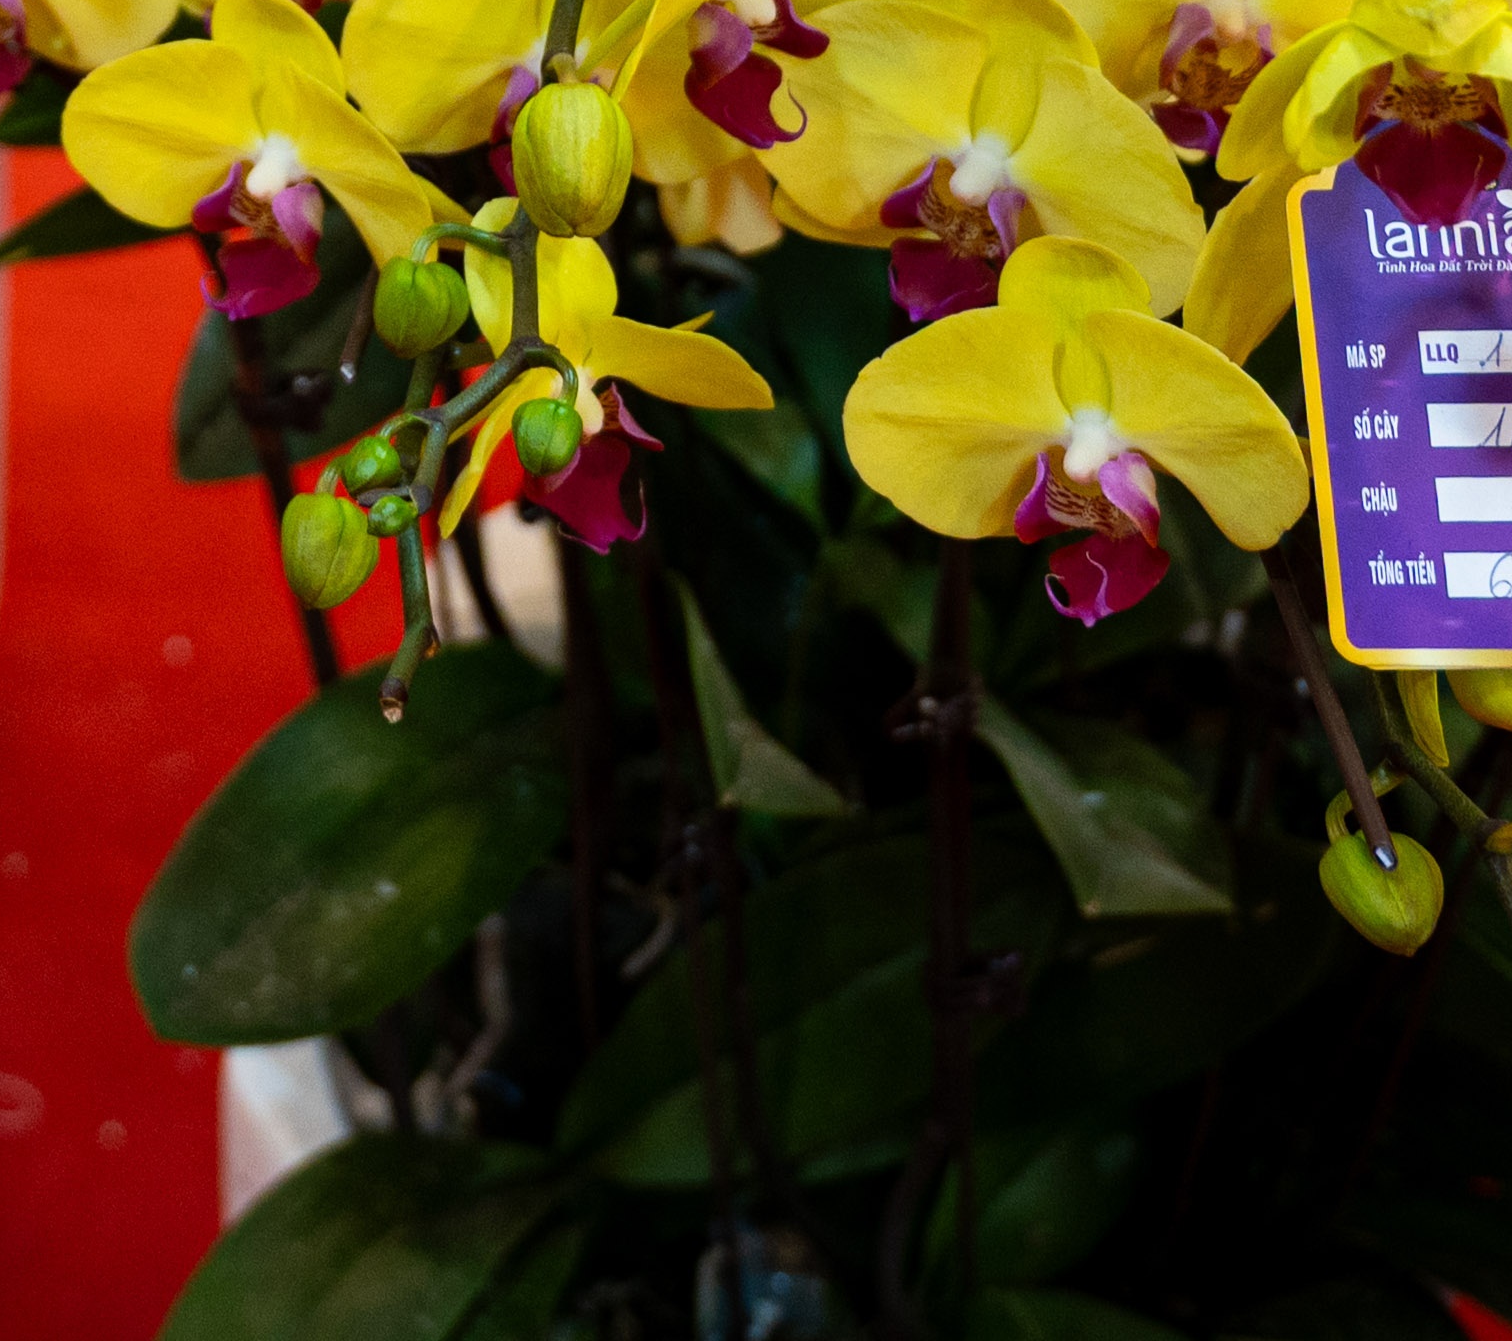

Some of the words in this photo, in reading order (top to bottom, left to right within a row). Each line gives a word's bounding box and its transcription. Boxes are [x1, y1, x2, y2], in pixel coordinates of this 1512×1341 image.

[1410, 260, 1435, 273] Hoa
[1439, 259, 1461, 272] Đất
[1465, 260, 1493, 272] Trời
[1345, 340, 1368, 368] MÃ
[1369, 345, 1386, 368] SP
[1426, 343, 1459, 363] LLQ
[1354, 407, 1371, 440] SỐ
[1374, 410, 1399, 439] CÂY
[1361, 481, 1398, 516] CHẬU
[1368, 549, 1404, 585] TỔNG
[1405, 552, 1436, 585] TIỀN
